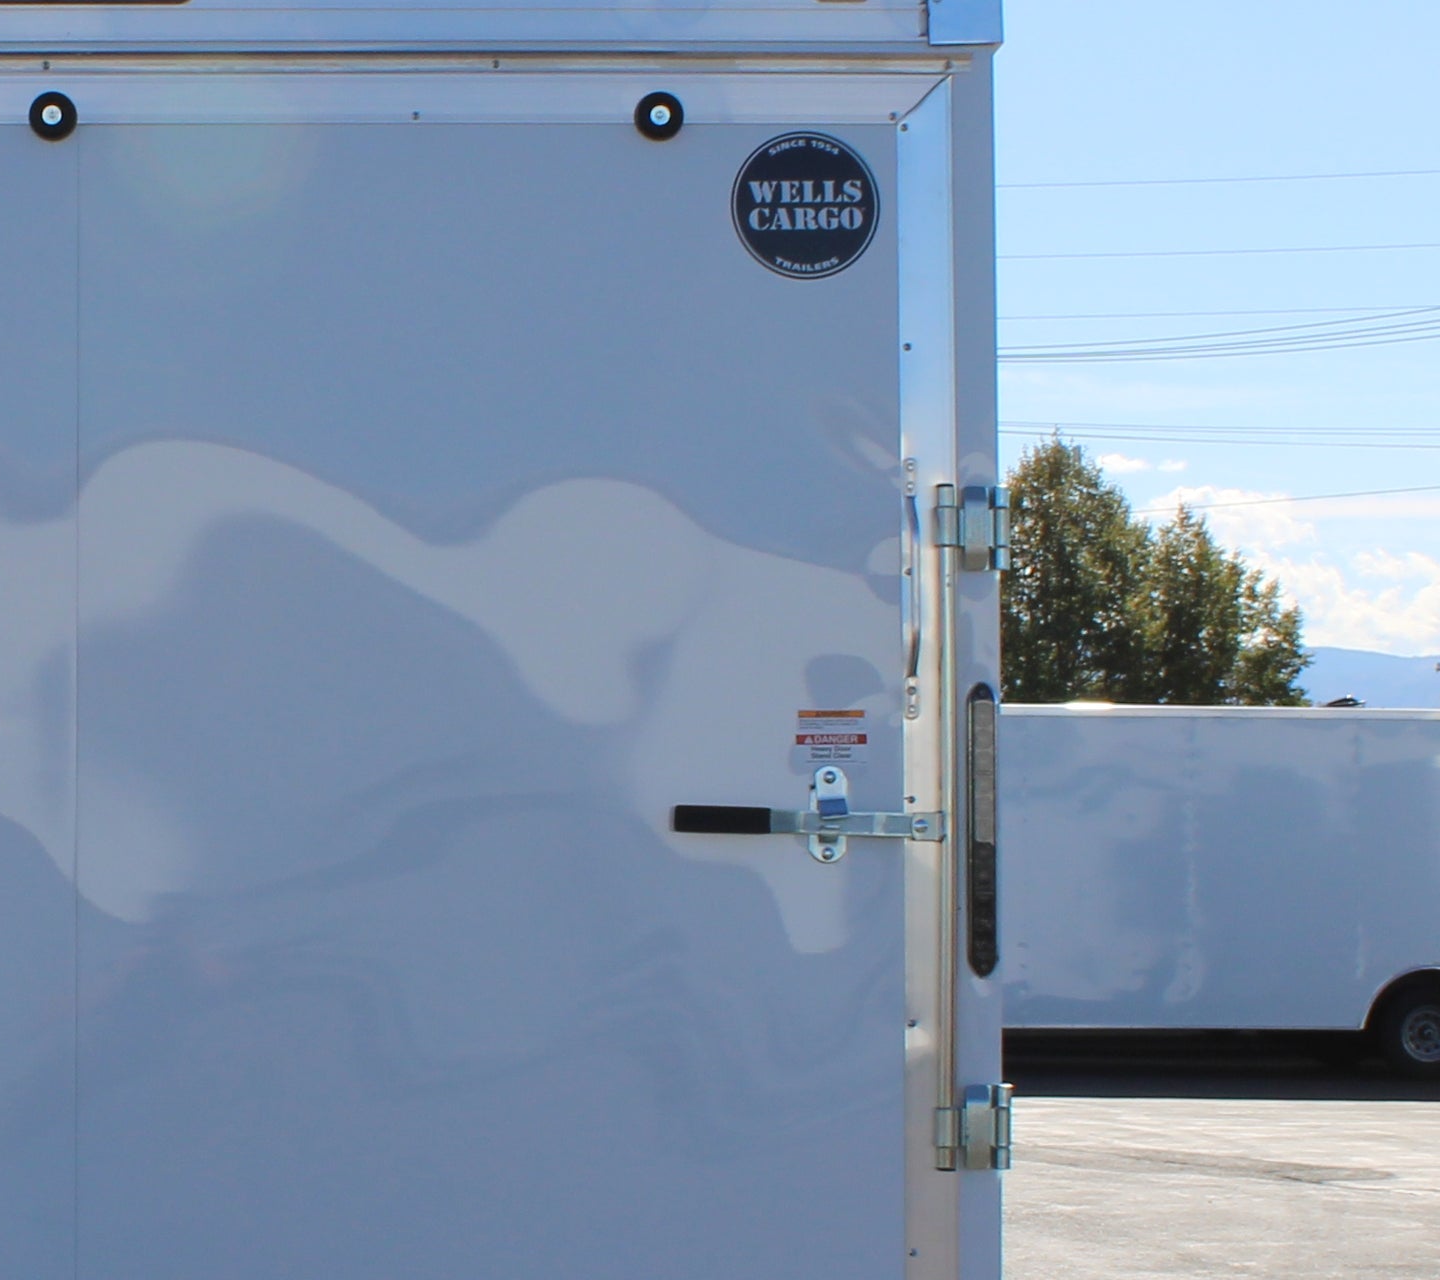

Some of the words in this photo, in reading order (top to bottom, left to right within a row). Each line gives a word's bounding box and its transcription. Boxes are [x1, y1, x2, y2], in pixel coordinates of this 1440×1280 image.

[768, 139, 806, 156] SINCE
[811, 140, 840, 155] 1954
[748, 180, 863, 203] WELLS
[748, 207, 864, 231] CARGO
[775, 256, 840, 272] TRAILERS
[814, 734, 859, 744] DANGER
